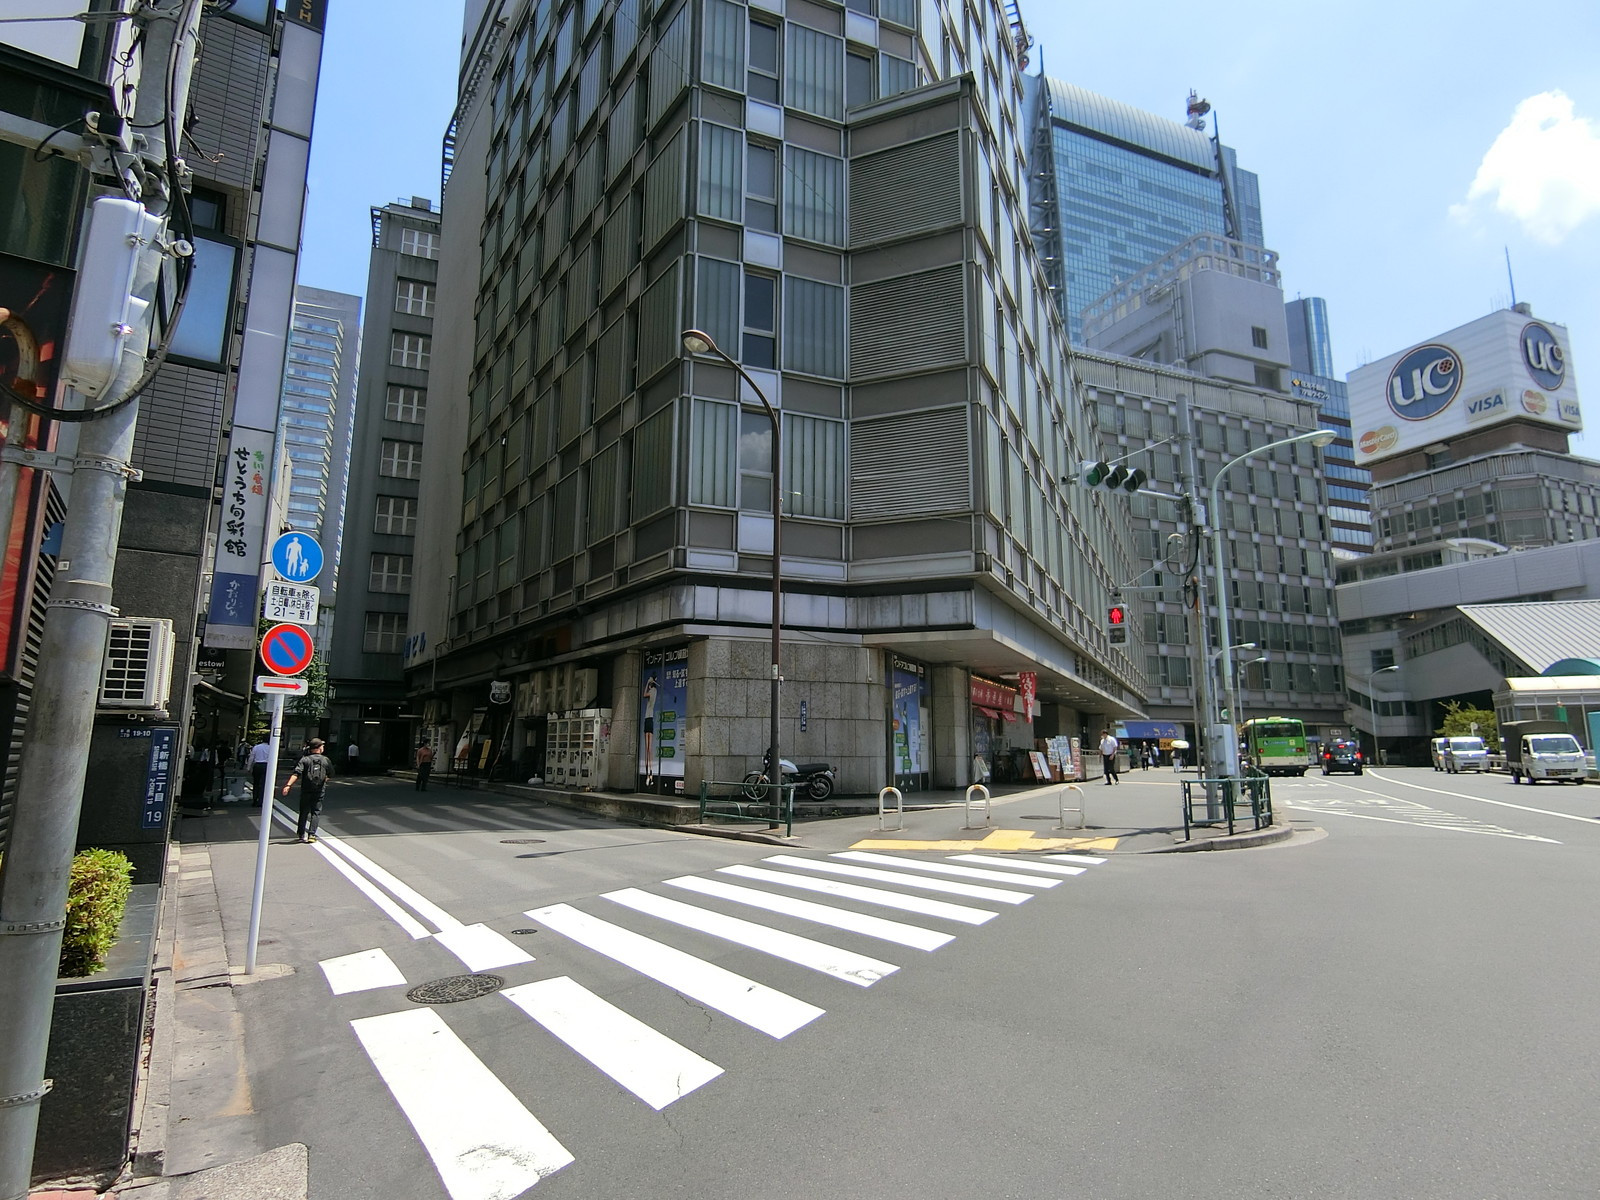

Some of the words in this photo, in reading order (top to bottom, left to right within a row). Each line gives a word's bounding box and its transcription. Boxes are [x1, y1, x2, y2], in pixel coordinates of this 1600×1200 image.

[1392, 357, 1455, 407] UC
[1468, 394, 1504, 415] VISA
[1359, 430, 1397, 450] MasterCard
[223, 446, 251, 558] せとうち旬彩館
[146, 811, 162, 822] 19
